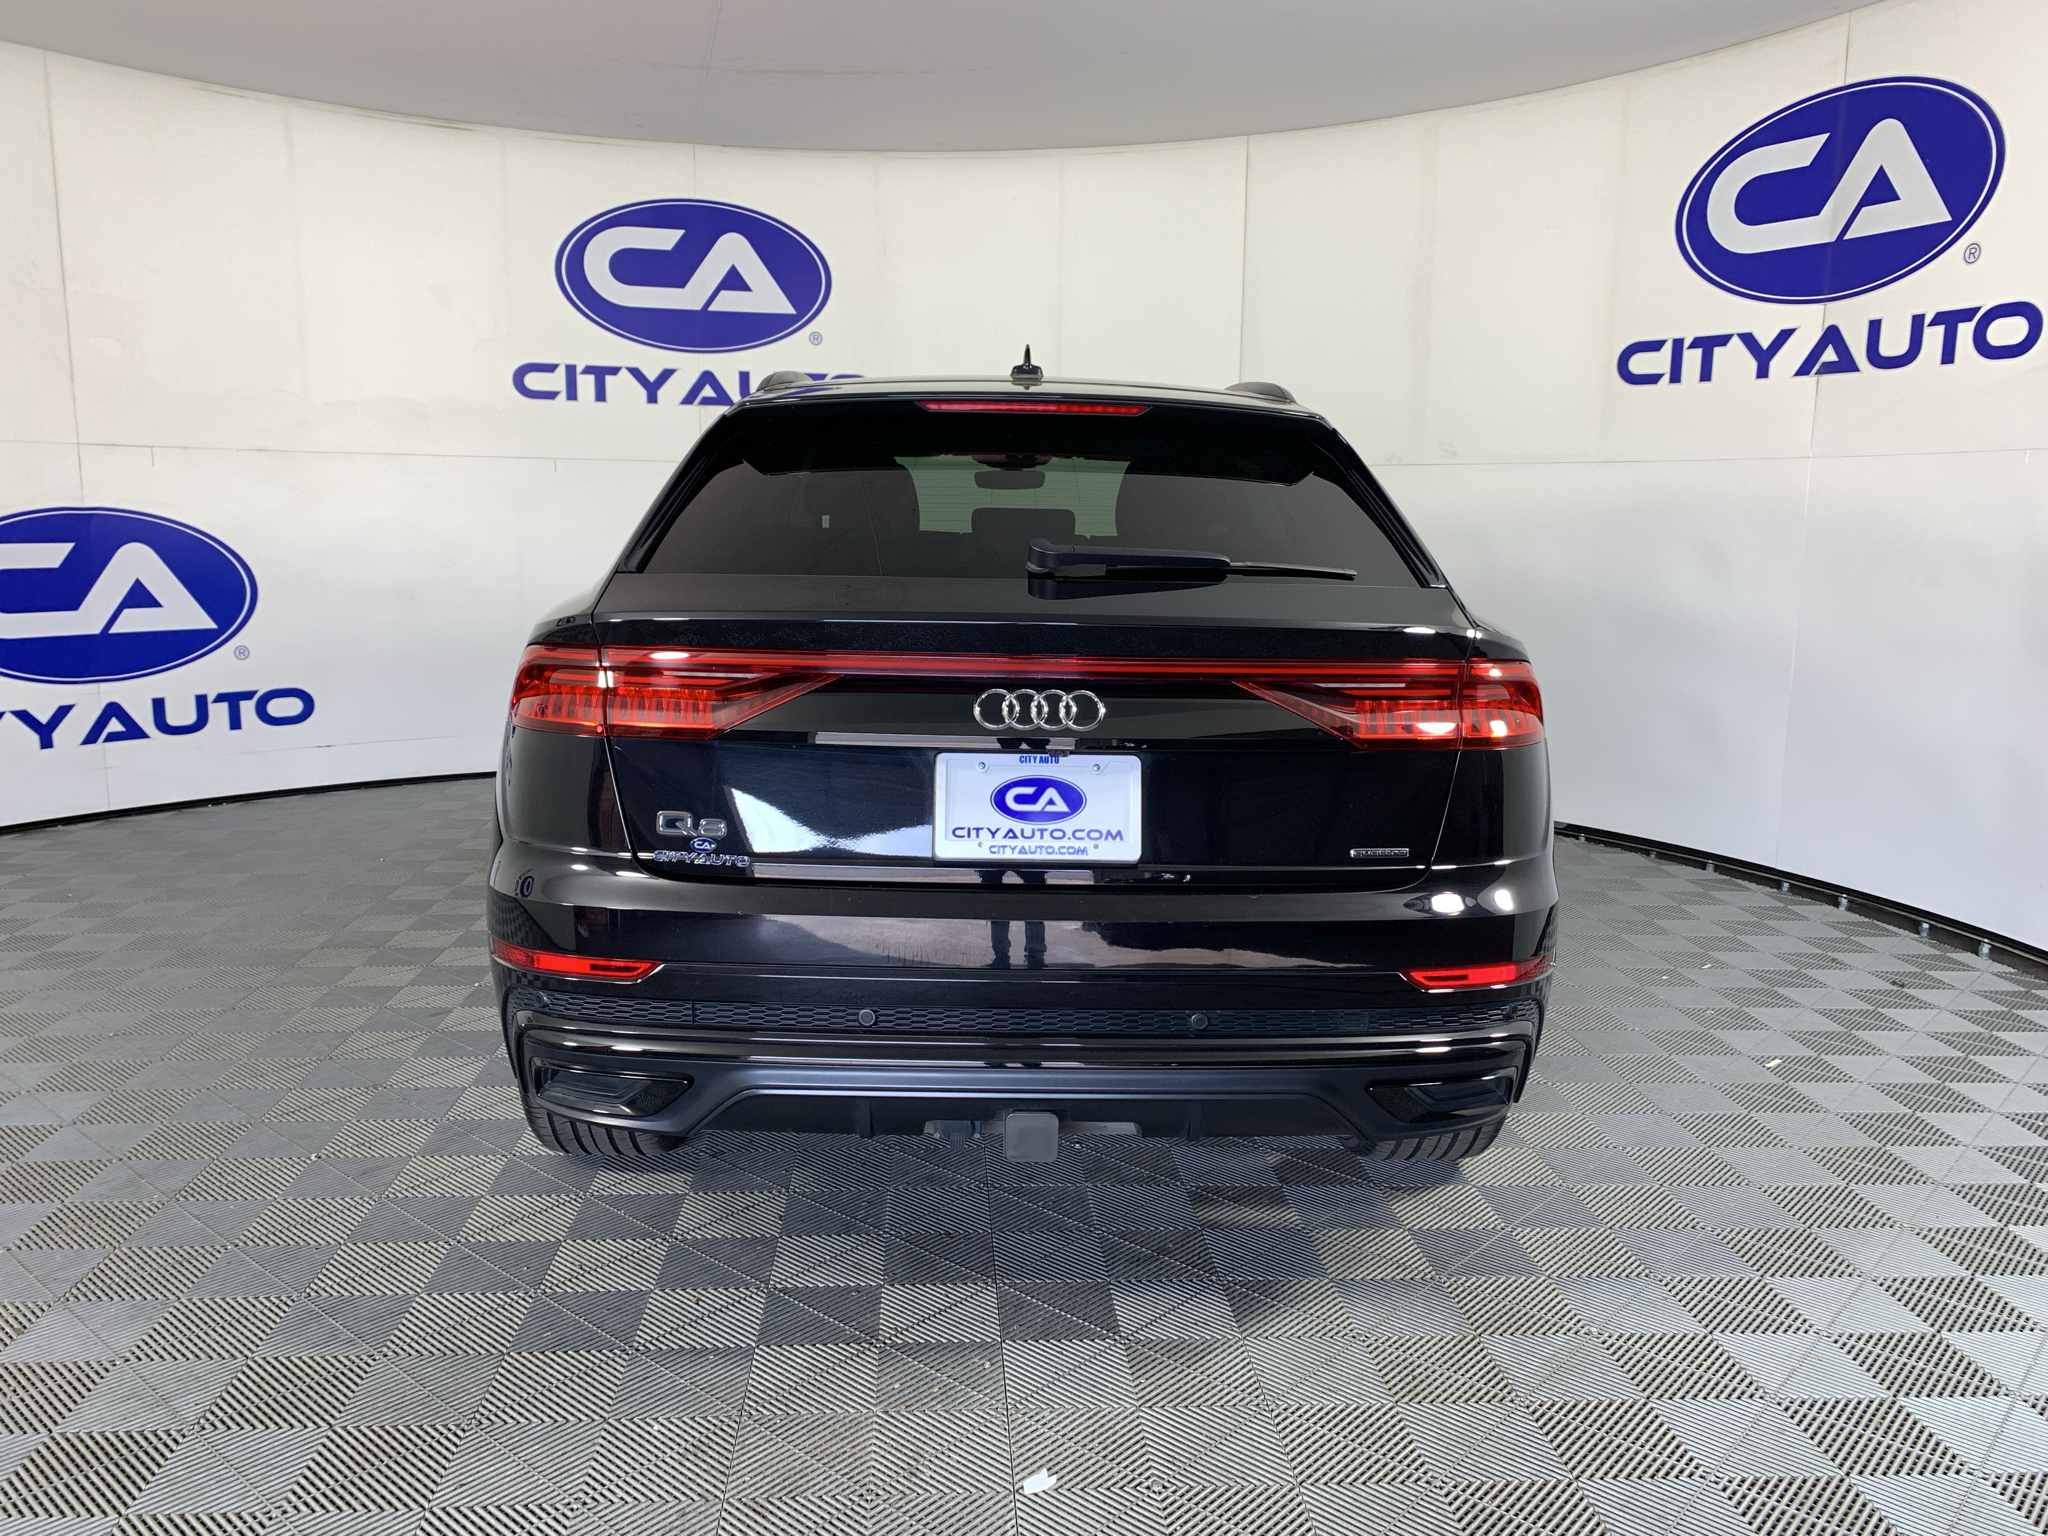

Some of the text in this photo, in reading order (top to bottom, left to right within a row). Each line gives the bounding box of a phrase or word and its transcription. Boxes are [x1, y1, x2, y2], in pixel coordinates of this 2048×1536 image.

[1707, 118, 1953, 254] CA
[584, 226, 798, 315] CA
[1019, 755, 1060, 765] CITY AUTO
[1004, 786, 1072, 813] CA
[655, 810, 728, 839] Q8
[951, 826, 1125, 842] CITYAUTO.COM
[988, 844, 1089, 856] CITYAUTO.COM
